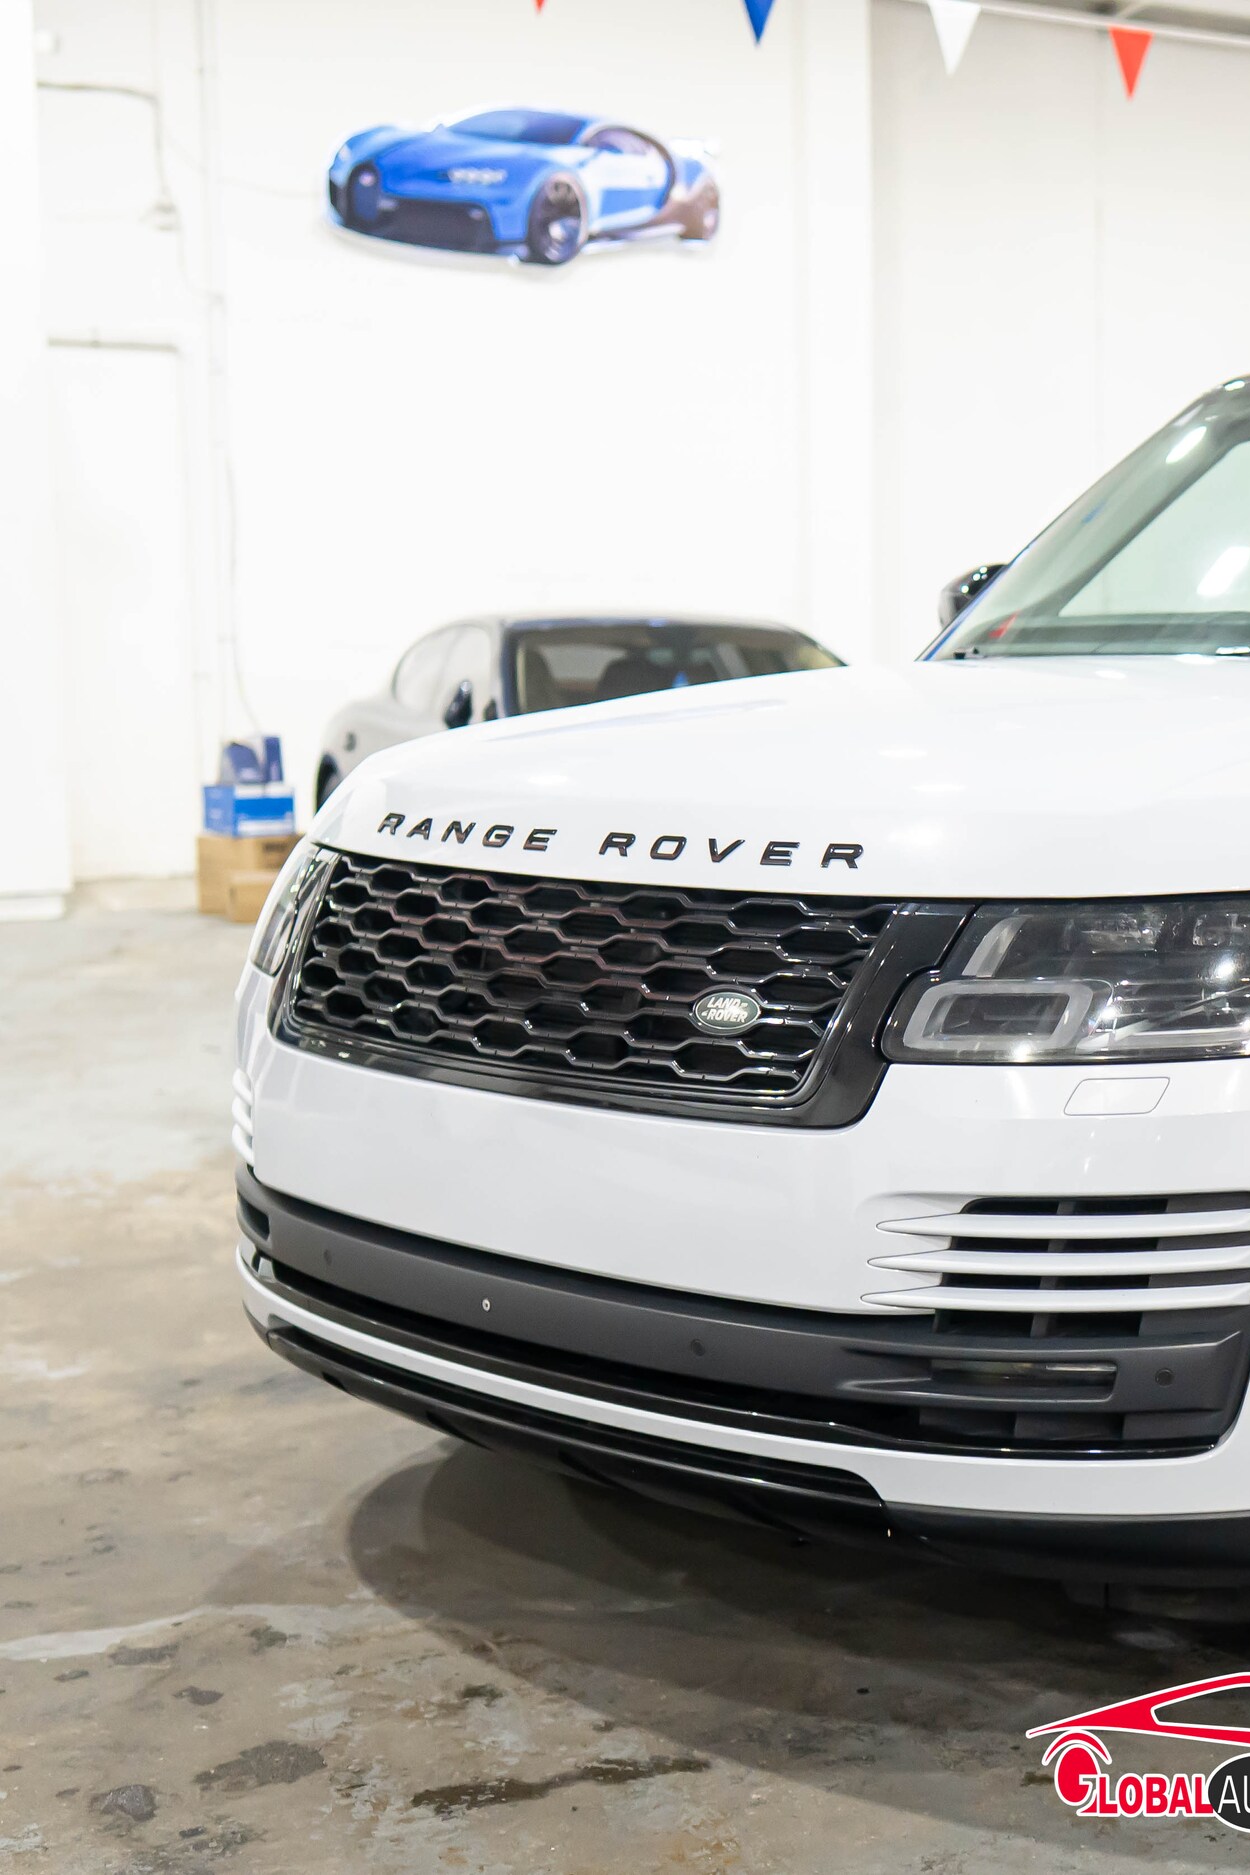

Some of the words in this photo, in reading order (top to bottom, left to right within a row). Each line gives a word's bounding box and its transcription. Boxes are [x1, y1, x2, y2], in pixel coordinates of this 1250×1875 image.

[376, 811, 559, 853] RANGE
[598, 831, 865, 870] ROVER
[706, 996, 742, 1009] LAND
[706, 1008, 749, 1023] ROVER
